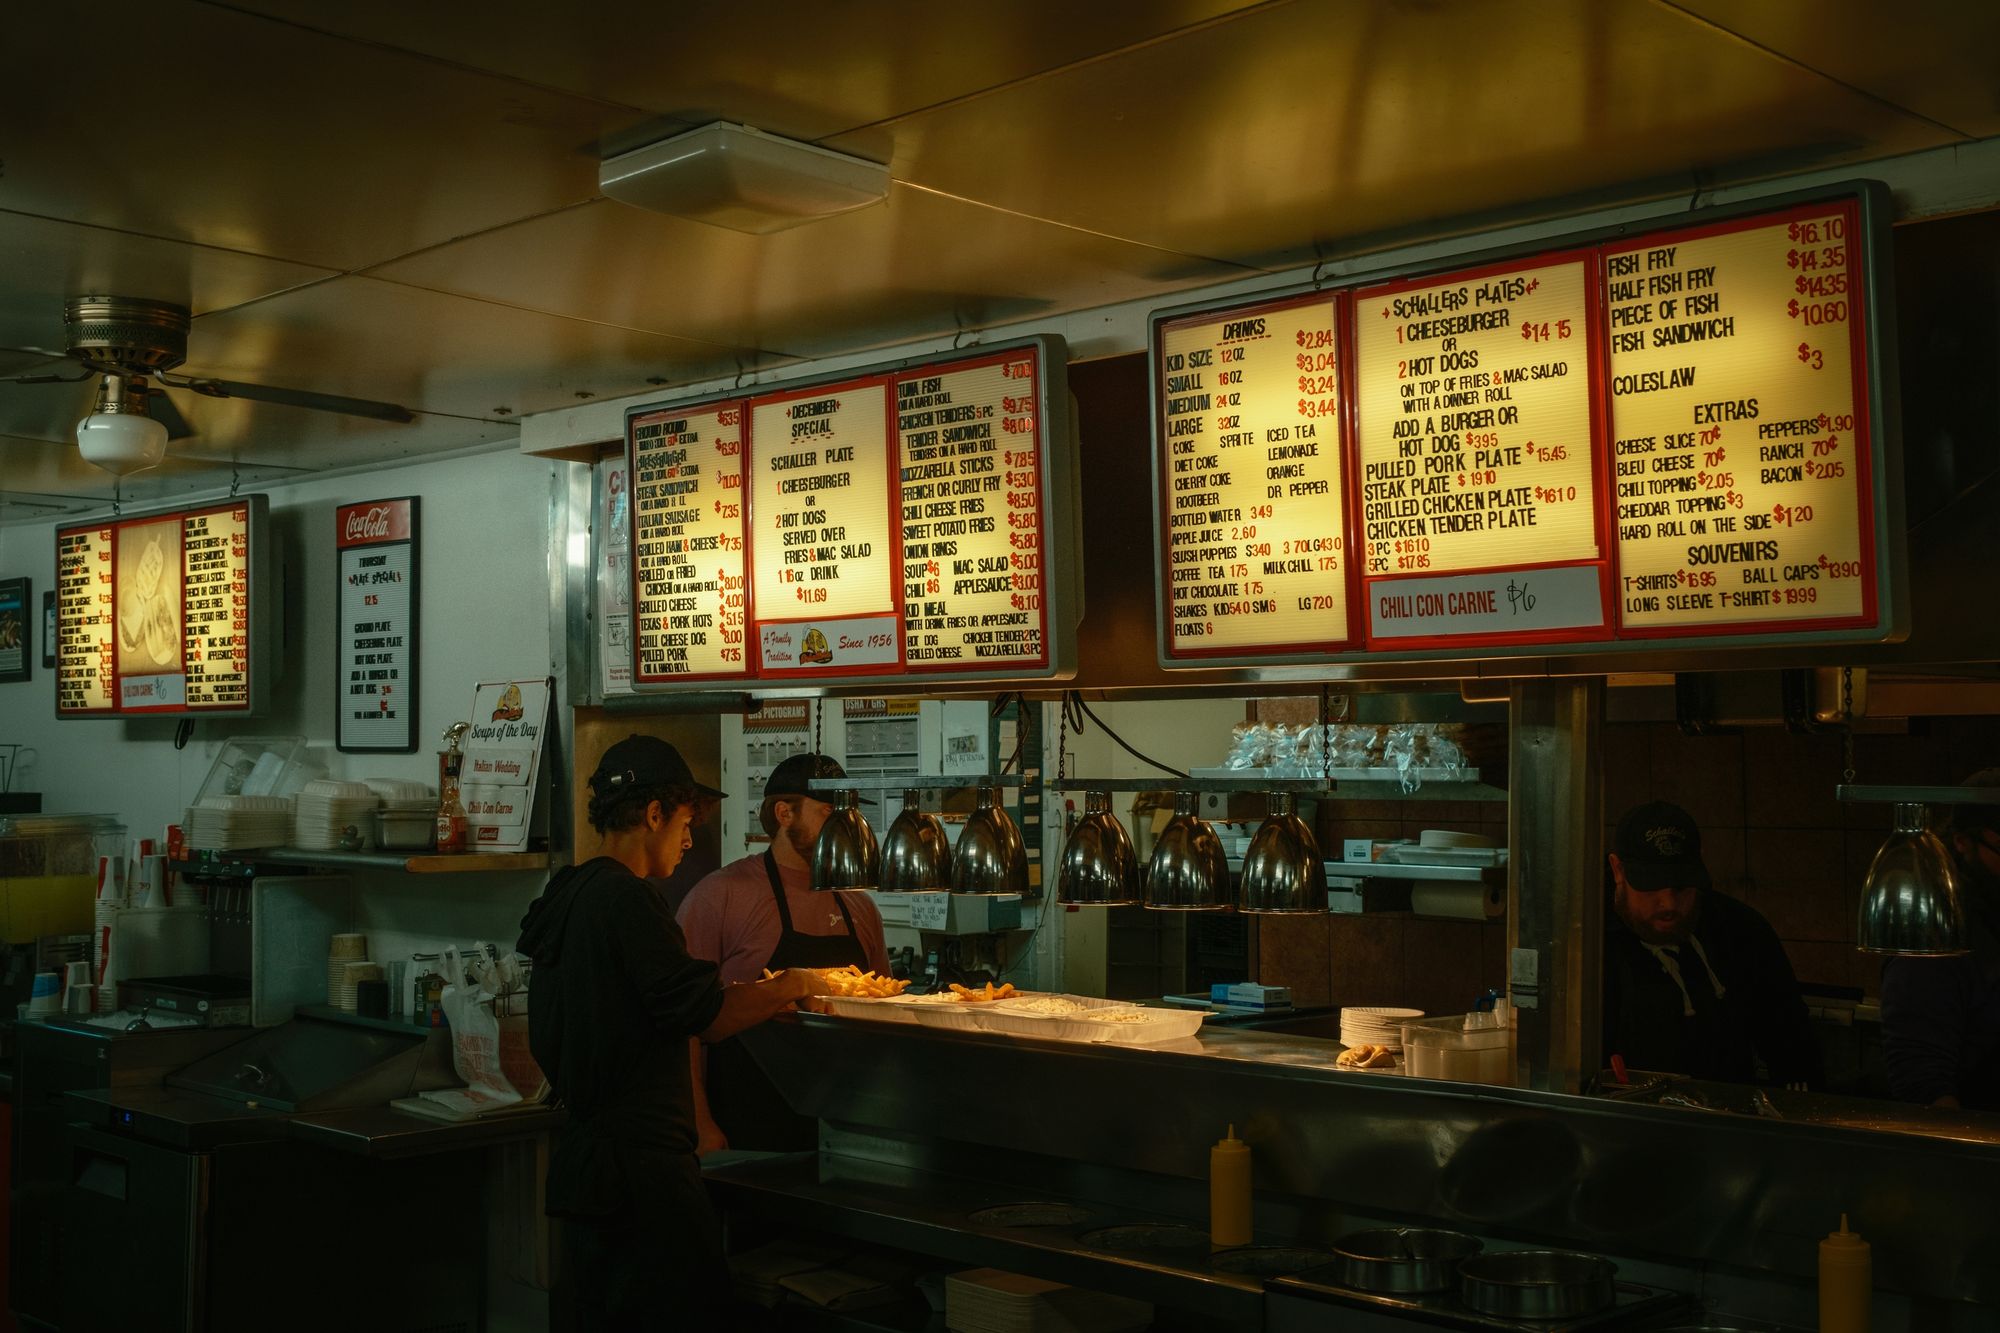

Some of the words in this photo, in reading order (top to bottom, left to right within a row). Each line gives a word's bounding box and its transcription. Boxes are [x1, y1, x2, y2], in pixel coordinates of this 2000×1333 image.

[1609, 253, 1639, 277] FISH
[1648, 248, 1676, 270] FRY
[1610, 278, 1644, 302] HALF
[1650, 274, 1682, 295] FISH
[1688, 266, 1716, 291] FRY
[1393, 287, 1468, 319] SCHALLERS
[1476, 278, 1525, 307] PLATES
[1612, 304, 1652, 328] PIECE
[1660, 299, 1677, 319] OF
[1686, 293, 1718, 314] FISH
[1223, 318, 1266, 340] DRINKS
[1396, 326, 1403, 344] 1
[1407, 309, 1509, 342] CHEESEBURGER
[1612, 331, 1644, 353] FISH
[1653, 317, 1734, 347] SANDWICH
[1442, 338, 1457, 352] OR
[1167, 355, 1184, 372] KID
[1189, 349, 1213, 368] SIZE
[1399, 361, 1406, 379] 2
[1409, 357, 1434, 377] HOT
[1441, 350, 1478, 372] DOGS
[1798, 343, 1823, 370] $3
[922, 378, 941, 393] FISH
[1168, 374, 1203, 393] SMALL
[1401, 384, 1414, 397] ON
[1419, 380, 1440, 395] TOP
[1444, 378, 1456, 392] OF
[1460, 373, 1490, 390] FRIES
[1493, 372, 1502, 385] &
[1503, 367, 1529, 384] MAC
[1531, 362, 1567, 381] SALAD
[1613, 367, 1696, 396] COLESLAW
[792, 401, 837, 419] DECEMBER
[1168, 394, 1211, 415] MEDIUM
[1694, 398, 1758, 424] EXTRAS
[900, 412, 933, 430] CHICKEN
[936, 405, 975, 424] TENDERS
[792, 419, 831, 437] SPECIAL
[1169, 418, 1203, 437] LARGE
[1267, 429, 1289, 442] ICED
[1296, 425, 1315, 438] TEA
[1759, 420, 1819, 440] PEPPERS
[1173, 441, 1195, 454] COKE
[1220, 432, 1254, 448] SPRITE
[771, 452, 817, 471] SCHALLER
[826, 447, 854, 464] PLATE
[1268, 443, 1318, 461] LEMONADE
[1760, 443, 1803, 462] RANCH
[960, 457, 994, 474] STICKS
[1366, 460, 1415, 481] PULLED
[1425, 453, 1465, 475] PORK
[1476, 447, 1521, 469] PLATE
[1617, 459, 1645, 476] BLEU
[1653, 452, 1694, 471] CHEESE
[782, 473, 850, 494] CHEESEBURGER
[1761, 466, 1802, 484] BACON
[659, 480, 698, 496] SANDWICH
[937, 483, 950, 497] OR
[952, 478, 981, 494] CURLY
[984, 476, 1001, 490] FRY
[1268, 486, 1282, 499] DR
[1290, 481, 1328, 496] PEPPER
[1365, 480, 1404, 502] STEAK
[1412, 475, 1450, 496] PLATE
[806, 496, 815, 507] OR
[903, 505, 922, 520] CHILI
[925, 501, 956, 518] CHEESE
[960, 499, 984, 515] FRIES
[1177, 493, 1219, 509] ROOTBEER
[1366, 499, 1419, 521] GRILLED
[1423, 492, 1485, 515] CHICKEN
[1489, 487, 1531, 508] PLATE
[1618, 501, 1669, 520] CHEDDAR
[1678, 495, 1725, 514] TOPPING
[346, 507, 391, 540] Coca-Cola
[782, 513, 798, 528] HOT
[803, 510, 826, 525] DOGS
[1172, 512, 1206, 526] BOTTLED
[1209, 508, 1241, 523] WATER
[783, 530, 817, 546] SERVED
[821, 527, 845, 542] OVER
[903, 524, 931, 540] SWEET
[934, 520, 966, 537] POTATO
[970, 517, 994, 533] FRIES
[1172, 532, 1197, 546] APPLE
[1199, 529, 1222, 543] JUICE
[785, 549, 808, 565] FRIES
[817, 546, 836, 562] MAC
[841, 543, 871, 559] SALAD
[904, 544, 928, 559] ONION
[932, 541, 957, 556] RINGS
[1688, 540, 1778, 566] SOUVENIRS
[810, 565, 839, 580] DRINK
[954, 576, 1012, 595] APPLESAUCE
[1624, 575, 1677, 592] T-SHIRTS
[1175, 605, 1207, 618] SHAKES
[1380, 592, 1412, 619] CHILI
[1417, 594, 1444, 617] CON
[1449, 590, 1497, 614] CARNE
[641, 617, 661, 630] TEXAS
[671, 615, 690, 628] PORK
[692, 614, 712, 627] HOTS
[387, 637, 402, 647] PLATE
[661, 633, 688, 646] CHEESE
[691, 632, 706, 645] DOG
[771, 630, 792, 646] Family
[838, 635, 864, 650] Since
[868, 631, 892, 648] 1956
[641, 649, 664, 662] PULLED
[668, 648, 688, 660] PORK
[765, 649, 792, 662] Tradition
[472, 724, 496, 742] Soups
[497, 723, 506, 742] of
[506, 724, 518, 737] the
[521, 722, 537, 741] Day
